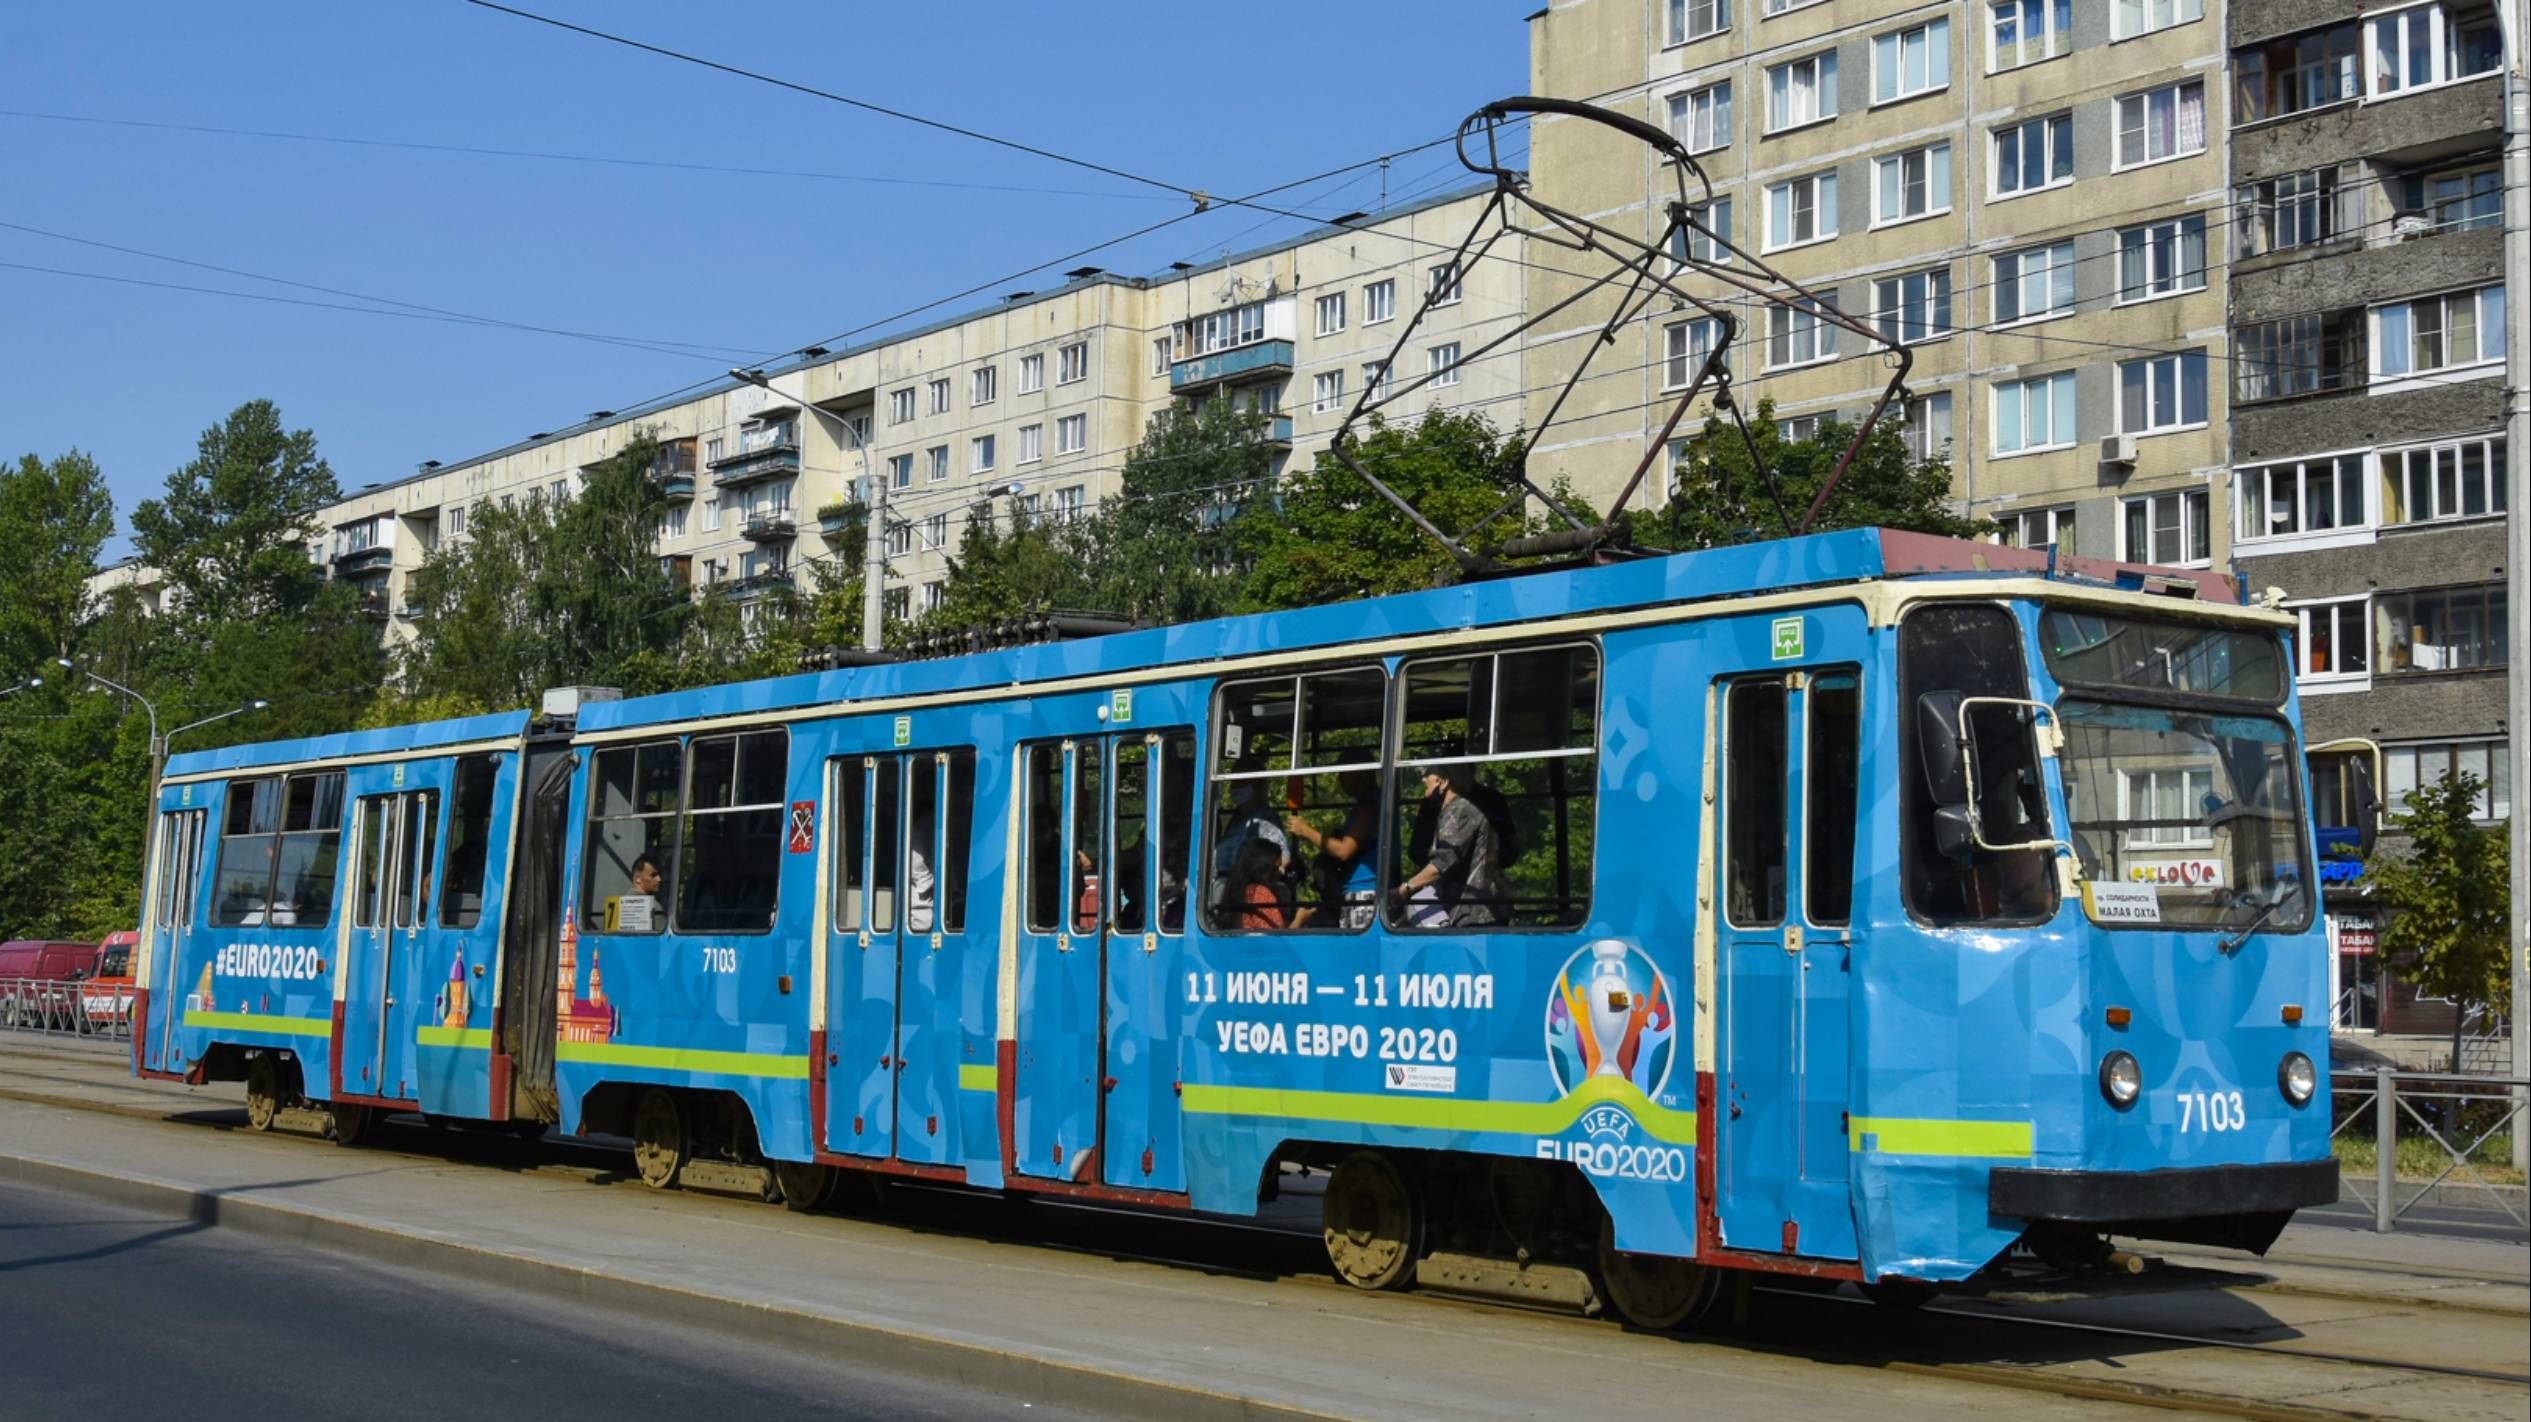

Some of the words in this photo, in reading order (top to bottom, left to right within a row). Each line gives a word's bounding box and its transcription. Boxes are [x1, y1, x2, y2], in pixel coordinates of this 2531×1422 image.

[608, 902, 616, 928] 7
[2098, 906, 2131, 917] МАЛАЯ
[2134, 908, 2157, 918] ОХТА
[2340, 918, 2374, 929] ТАБА
[2340, 935, 2374, 945] ТАБА
[216, 943, 318, 980] #EURO2020
[703, 947, 736, 973] 7103
[1188, 972, 1217, 1002] 11
[1226, 971, 1308, 1005] ИЮНЯ
[1354, 974, 1388, 1007] 11
[1399, 973, 1493, 1008] ИЮЛЯ
[1216, 1020, 1288, 1054] УЕФА
[1295, 1023, 1369, 1058] ЕВРО
[1379, 1026, 1458, 1062] 2020
[2177, 1091, 2246, 1133] 7103
[1583, 1112, 1629, 1139] UEFA
